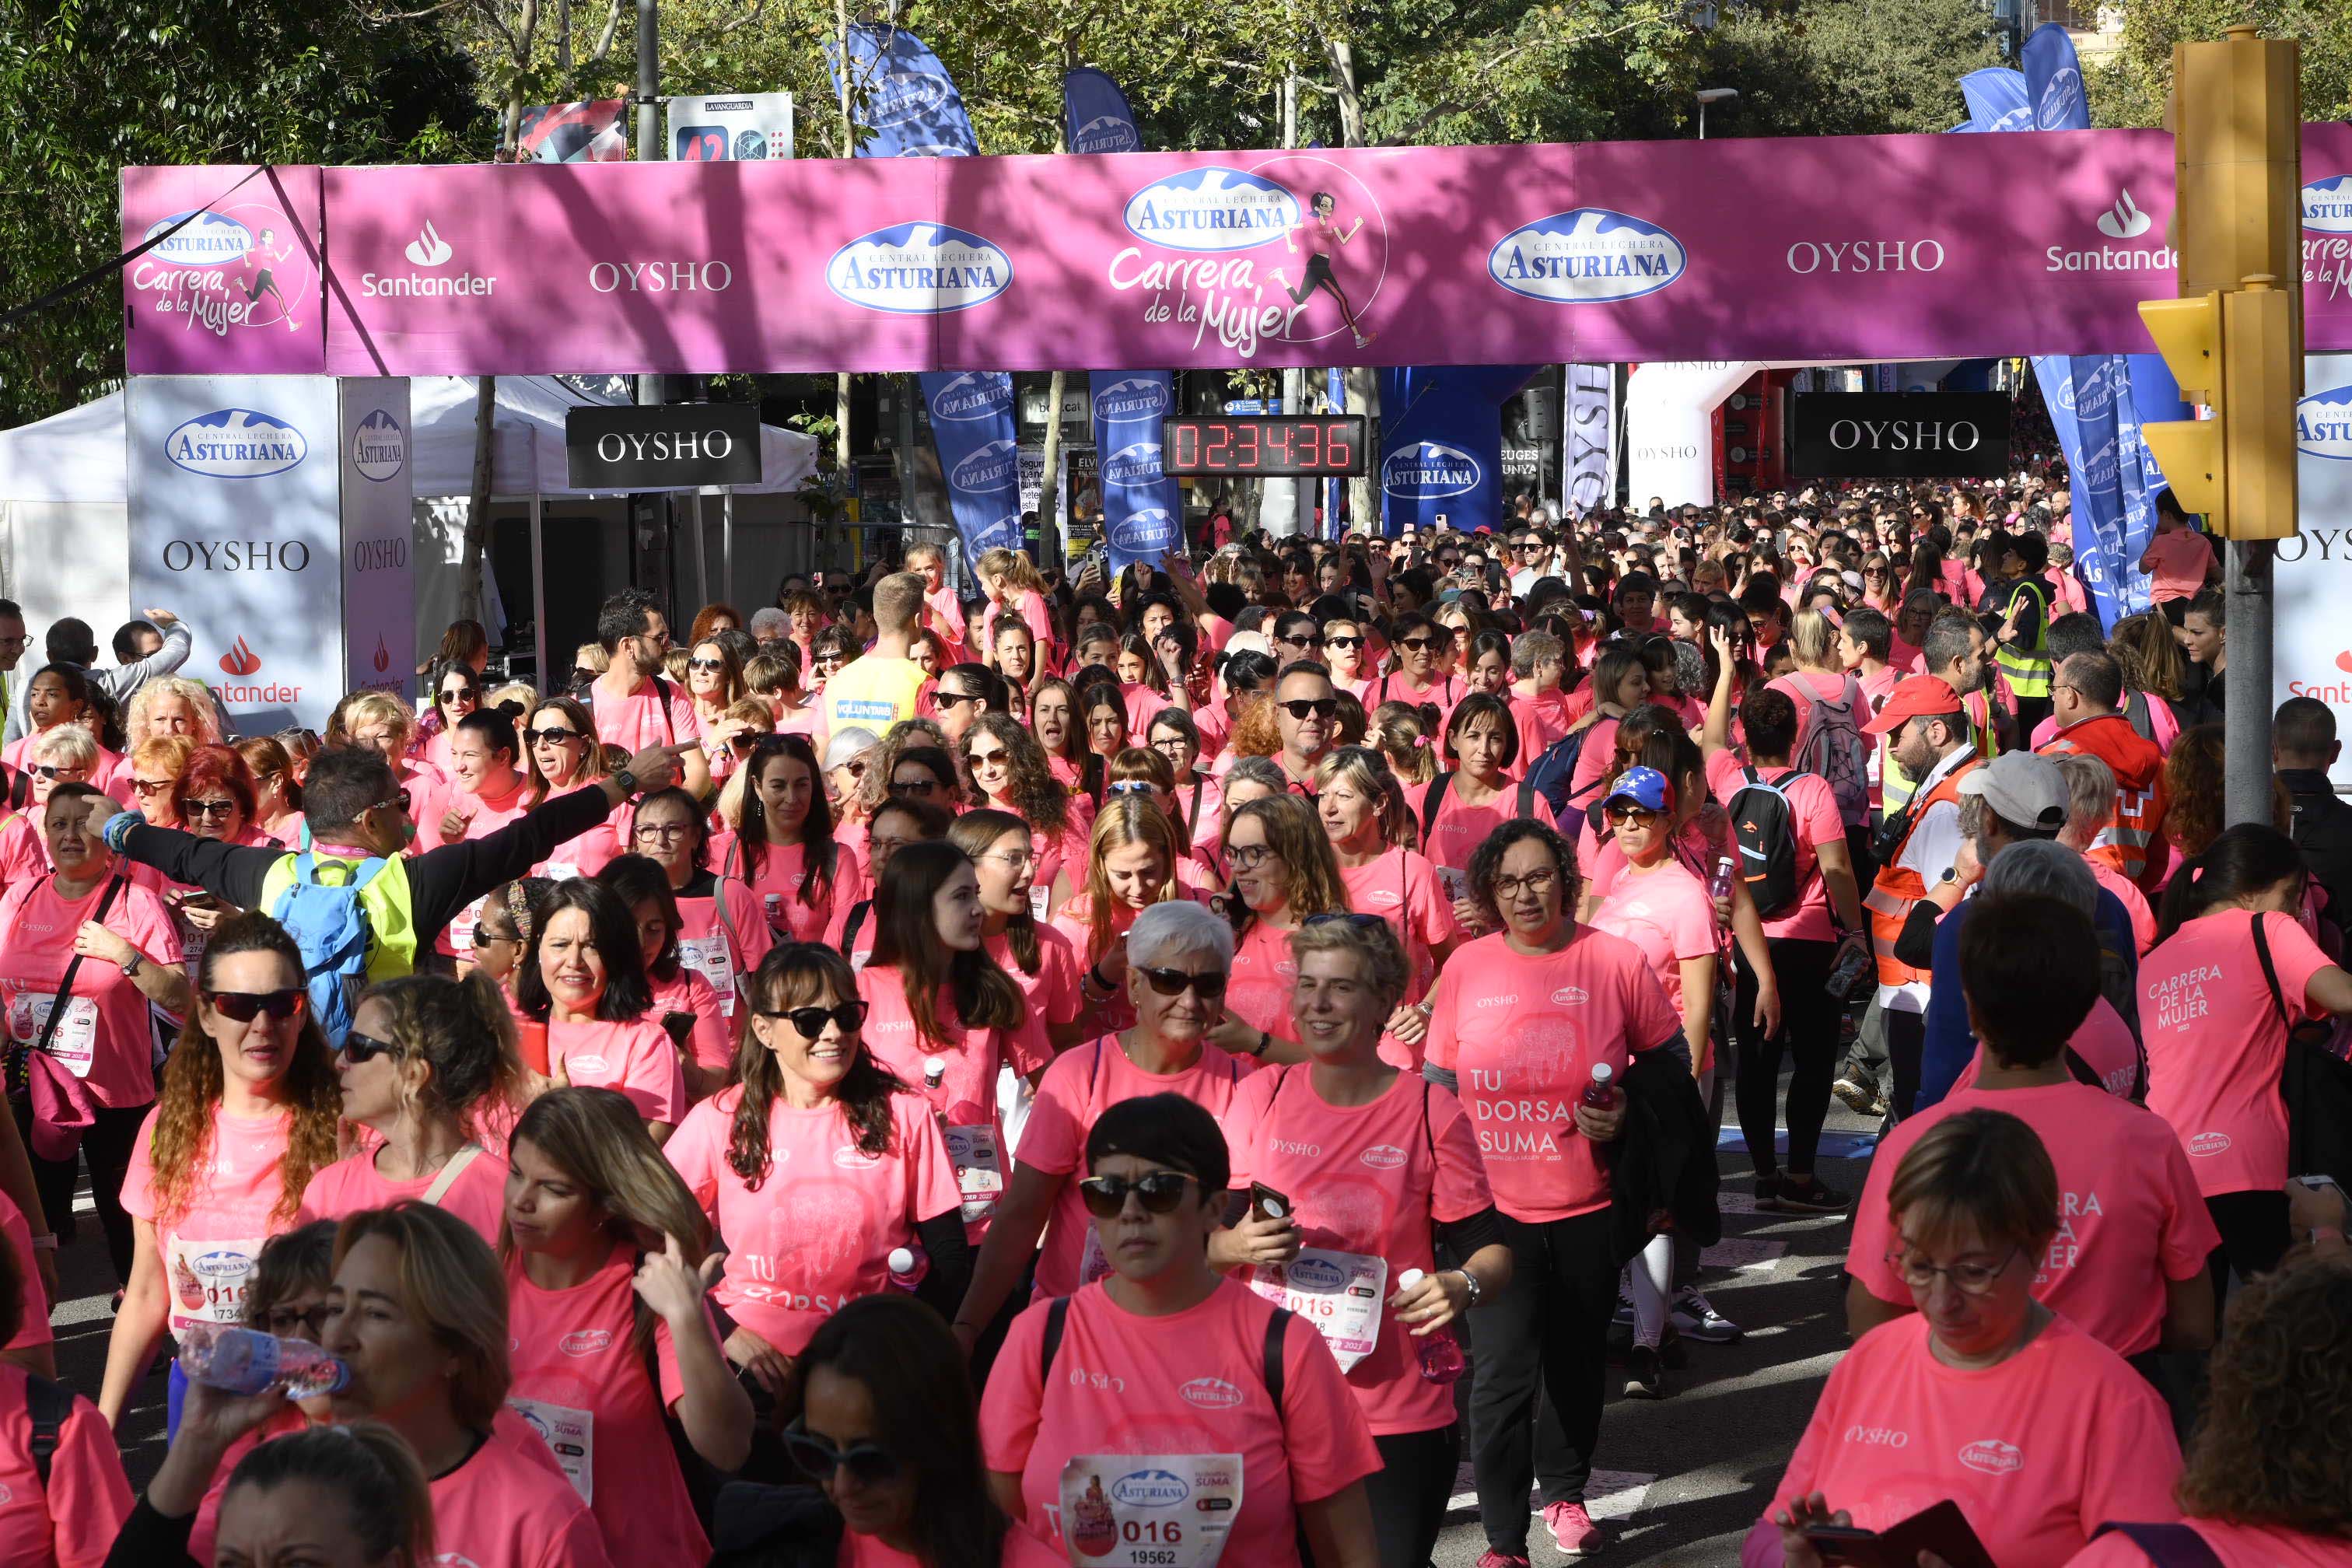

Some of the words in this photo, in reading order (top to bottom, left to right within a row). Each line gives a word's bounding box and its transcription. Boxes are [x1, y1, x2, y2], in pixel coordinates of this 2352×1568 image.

[1225, 194, 1282, 204] LECHERA
[1137, 199, 1286, 231] ASTURIANA
[1535, 242, 1594, 251] CENTRAL
[1597, 240, 1664, 250] LECHERA
[870, 254, 928, 262] CENTRAL
[933, 253, 992, 261] LECHERA
[1503, 243, 1671, 280] ASTURIANA
[1788, 240, 1945, 273] OYSHO
[133, 261, 225, 292] Carrera
[589, 261, 732, 292] OYSHO
[842, 254, 999, 290] ASTURIANA
[1108, 247, 1249, 292] Carrera
[2319, 261, 2332, 283] la
[362, 271, 498, 297] Santander
[156, 294, 173, 313] de
[177, 293, 188, 313] la
[187, 288, 259, 337] Mujer
[1144, 294, 1171, 323] de
[1176, 292, 1196, 324] la
[1192, 284, 1309, 358] Mujer
[1829, 419, 1980, 452] OYSHO
[177, 433, 296, 461] ASTURIANA
[357, 437, 401, 464] ASTURIANA
[597, 429, 733, 463] OYSHO
[1177, 425, 1349, 467] 02:34:36
[1501, 450, 1538, 460] EUGES
[1638, 445, 1697, 460] OYSHO
[1385, 470, 1473, 487] ASTURIANA
[1503, 464, 1537, 474] UNYA
[163, 540, 310, 572] OYSHO
[354, 537, 405, 572] OYSHO
[214, 681, 301, 703] ntander
[1437, 824, 1467, 834] OYSHO
[1369, 894, 1399, 903] ASTURIANA
[19, 921, 53, 933] OYSHO
[187, 933, 207, 943] 01
[2148, 964, 2223, 1000] CARRERA
[1478, 993, 1518, 1009] OYSHO
[1554, 992, 1587, 1003] ASTURIANA
[2160, 990, 2178, 1012] DE
[2184, 983, 2204, 1004] LA
[2158, 999, 2208, 1030] MUJER
[37, 1024, 64, 1038] 06
[2177, 1024, 2190, 1033] 2023
[1471, 1069, 1502, 1091] TU
[1479, 1130, 1559, 1154] SUMA
[2189, 1139, 2228, 1153] ASTURIANA
[1363, 1152, 1405, 1165] ASTURIANA
[198, 1260, 250, 1272] ASTURIANA
[747, 1255, 775, 1283] TU
[1292, 1267, 1339, 1284] ASTURIANA
[1350, 1271, 1376, 1280] SUMA
[1291, 1297, 1335, 1316] 016
[563, 1336, 609, 1354] ASTURIANA
[1183, 1387, 1240, 1403] ASTURIANA
[555, 1425, 583, 1436] SUMA
[1118, 1482, 1184, 1498] ASTURIANA
[1195, 1478, 1230, 1487] SUMA
[1122, 1521, 1182, 1542] 016
[1130, 1549, 1175, 1565] 19562
